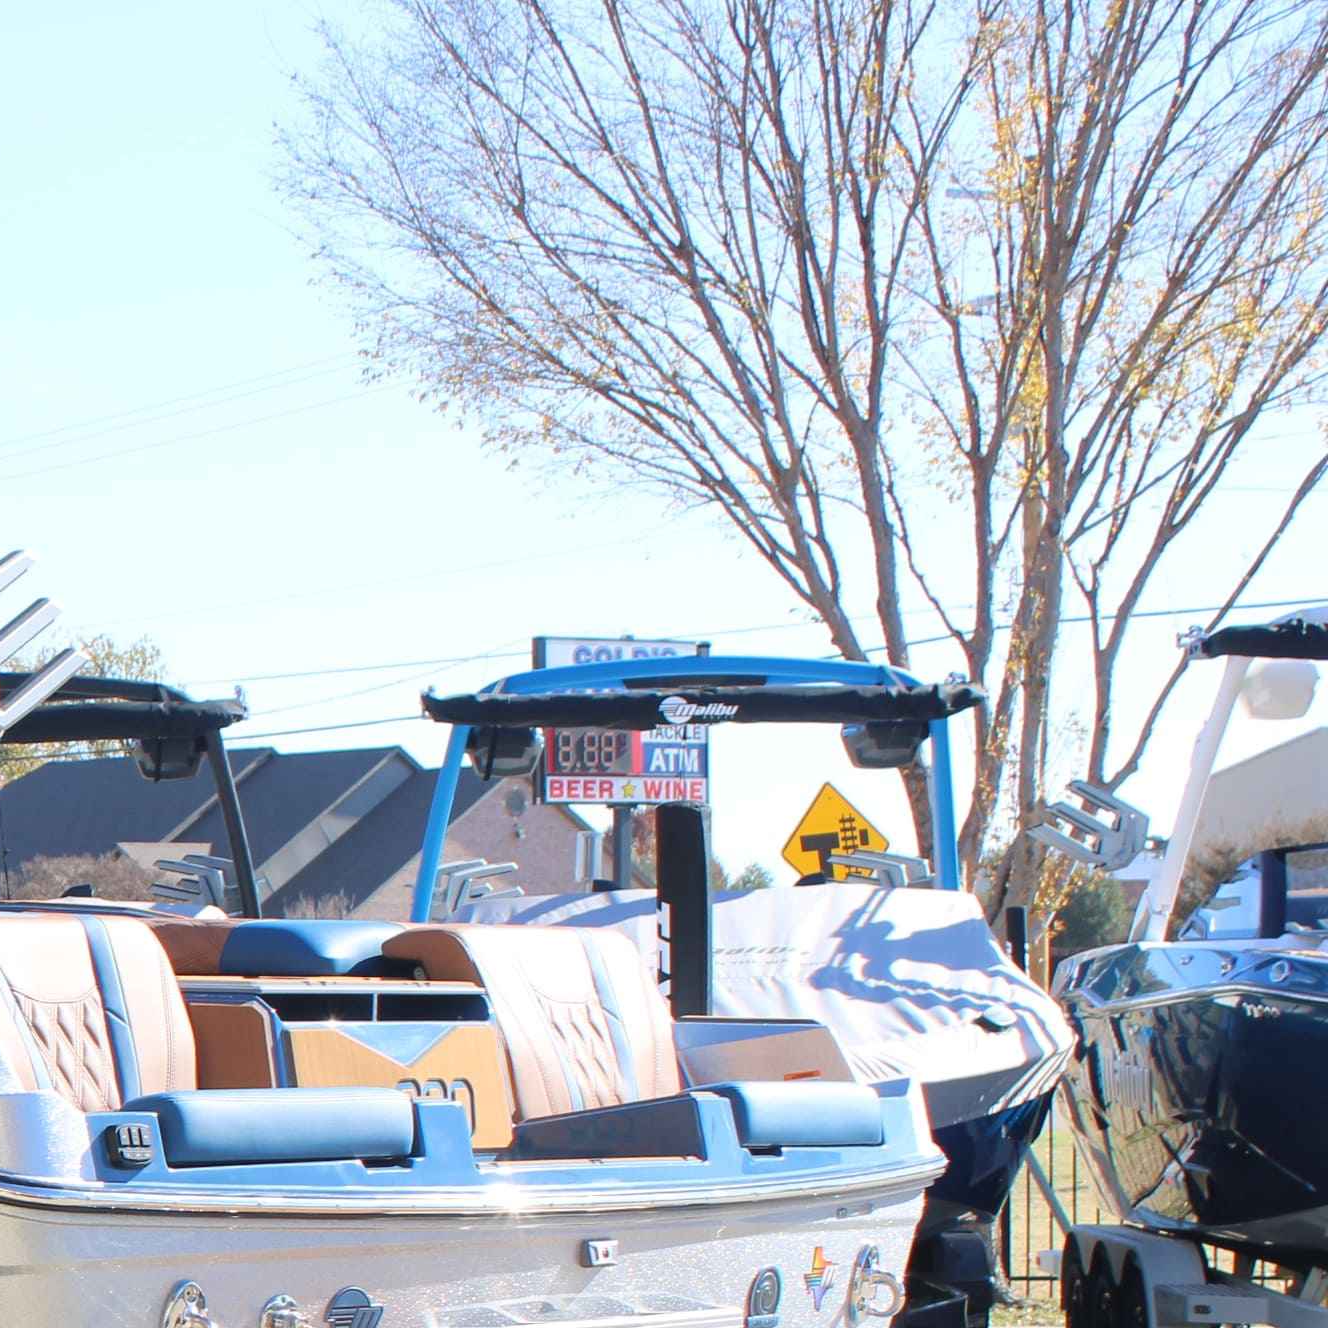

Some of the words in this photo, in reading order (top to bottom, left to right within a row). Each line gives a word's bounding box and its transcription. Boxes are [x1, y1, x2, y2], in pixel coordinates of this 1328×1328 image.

[648, 724, 702, 740] TACKLE
[649, 748, 700, 772] ATM
[549, 779, 614, 799] BEER
[644, 780, 704, 800] WINE
